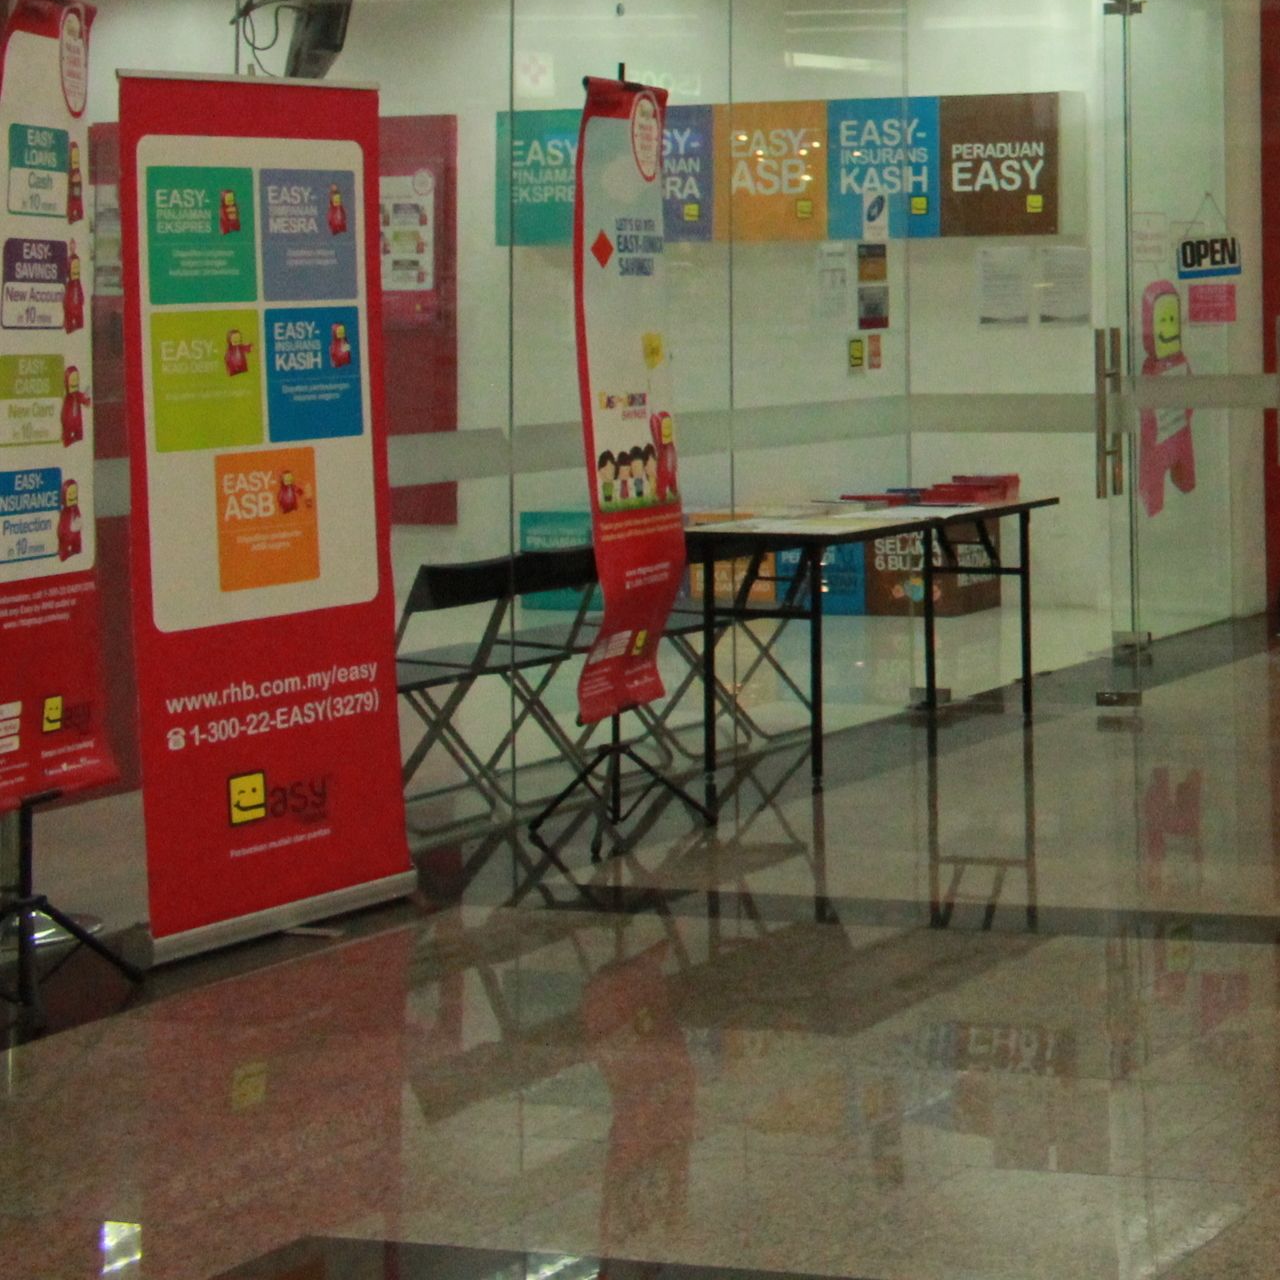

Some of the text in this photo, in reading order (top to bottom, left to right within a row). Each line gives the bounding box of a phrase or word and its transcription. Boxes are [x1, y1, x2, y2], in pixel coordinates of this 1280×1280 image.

[840, 118, 927, 147] EASY-
[840, 147, 929, 165] INSURANS
[951, 141, 1045, 160] PERADUAN
[731, 158, 807, 196] ASB
[840, 165, 929, 195] KASIH
[951, 159, 1045, 192] EASY
[156, 188, 210, 208] EASY-
[267, 186, 317, 205] EASY-
[269, 217, 319, 234] MESRA
[1181, 237, 1237, 269] OPEN
[15, 261, 58, 280] SAVINGS
[30, 286, 65, 302] Accoun
[273, 321, 321, 340] EASY-
[275, 351, 322, 372] KASIH
[15, 473, 44, 491] EASY-
[223, 470, 277, 495] EASY-
[0, 491, 59, 512] NSURANCE
[224, 492, 276, 522] ASB
[3, 519, 52, 536] Protection
[874, 556, 887, 571] 6
[166, 662, 378, 714] www.rhb.com.my/easy
[189, 688, 380, 746] 1-300-22-EASY(3279)
